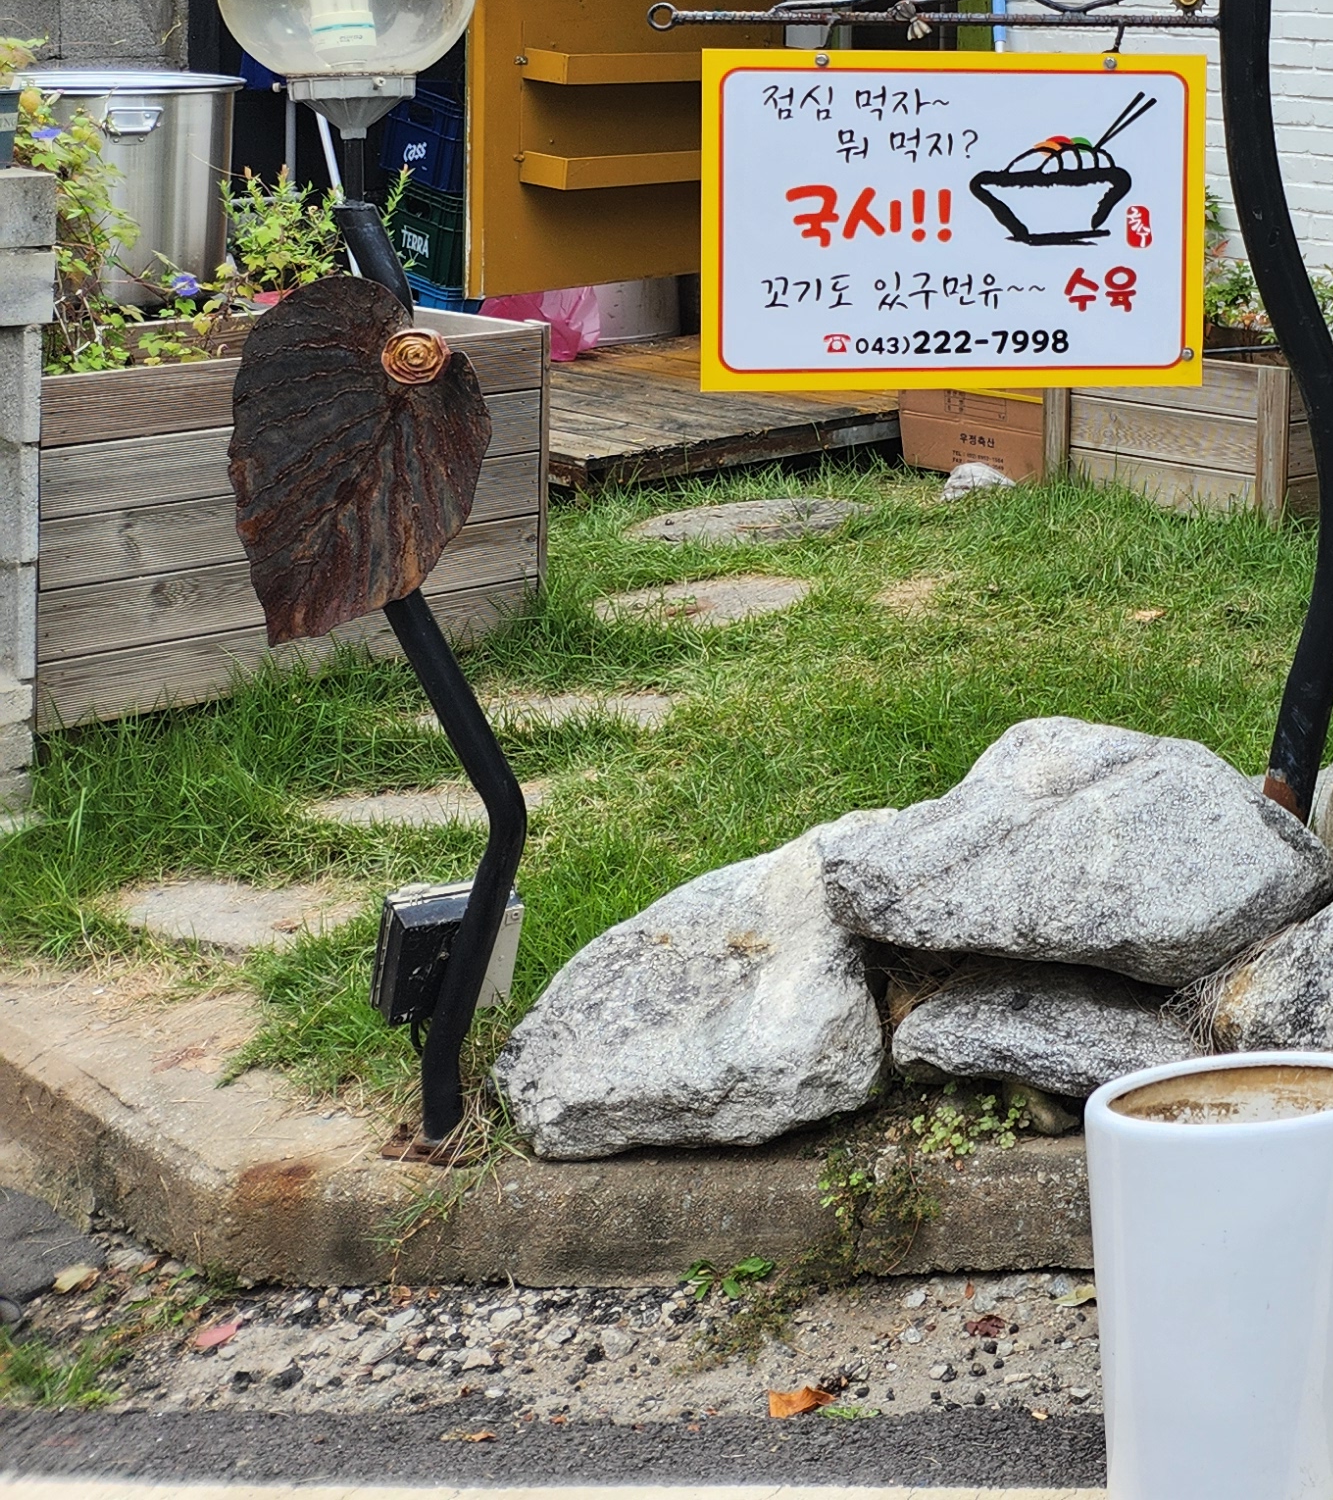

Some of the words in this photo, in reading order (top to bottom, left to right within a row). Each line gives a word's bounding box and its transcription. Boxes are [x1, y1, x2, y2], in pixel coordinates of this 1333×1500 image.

[762, 84, 834, 122] 점심
[855, 84, 950, 122] 먹자~
[836, 128, 869, 164] 뭐
[889, 126, 979, 163] 먹지?
[785, 184, 953, 249] 국시!!
[401, 228, 430, 259] TERRA
[760, 273, 853, 310] 꼬기도
[1063, 265, 1137, 313] 수육
[855, 328, 1071, 355] 043)222-7998
[959, 432, 995, 449] 우정축산
